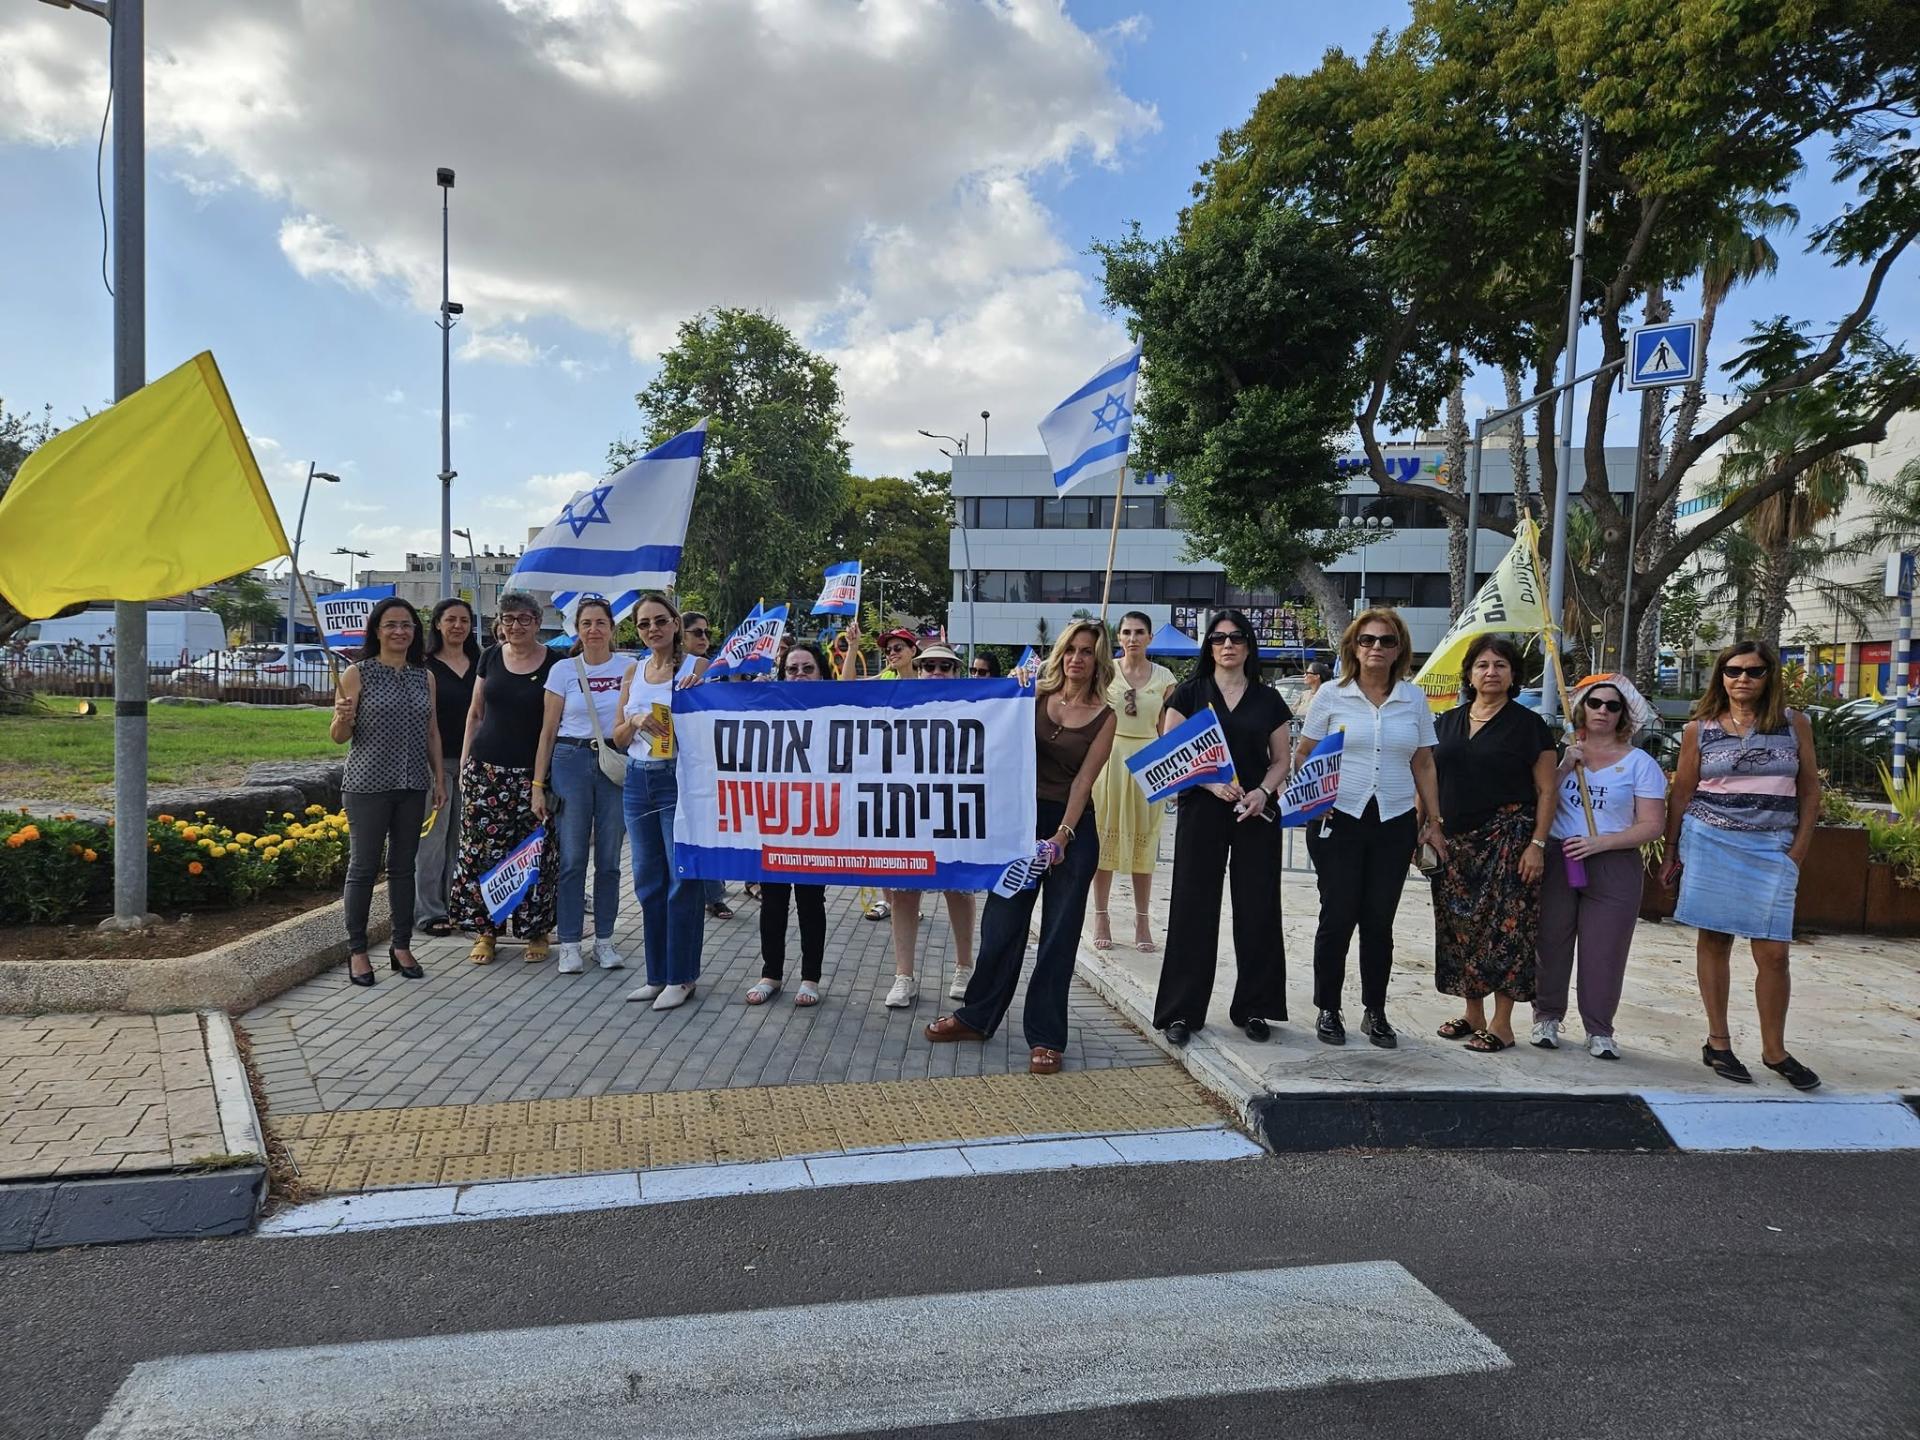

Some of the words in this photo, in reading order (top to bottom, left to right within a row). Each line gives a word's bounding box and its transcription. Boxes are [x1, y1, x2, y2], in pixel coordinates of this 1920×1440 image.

[714, 719, 813, 773] אותם
[828, 719, 985, 774] מחזירים
[716, 779, 841, 837] עכשיו!
[857, 783, 986, 839] הביתה
[1570, 795, 1607, 809] QIT
[868, 856, 909, 870] המשפחות
[909, 857, 928, 870] מטה
